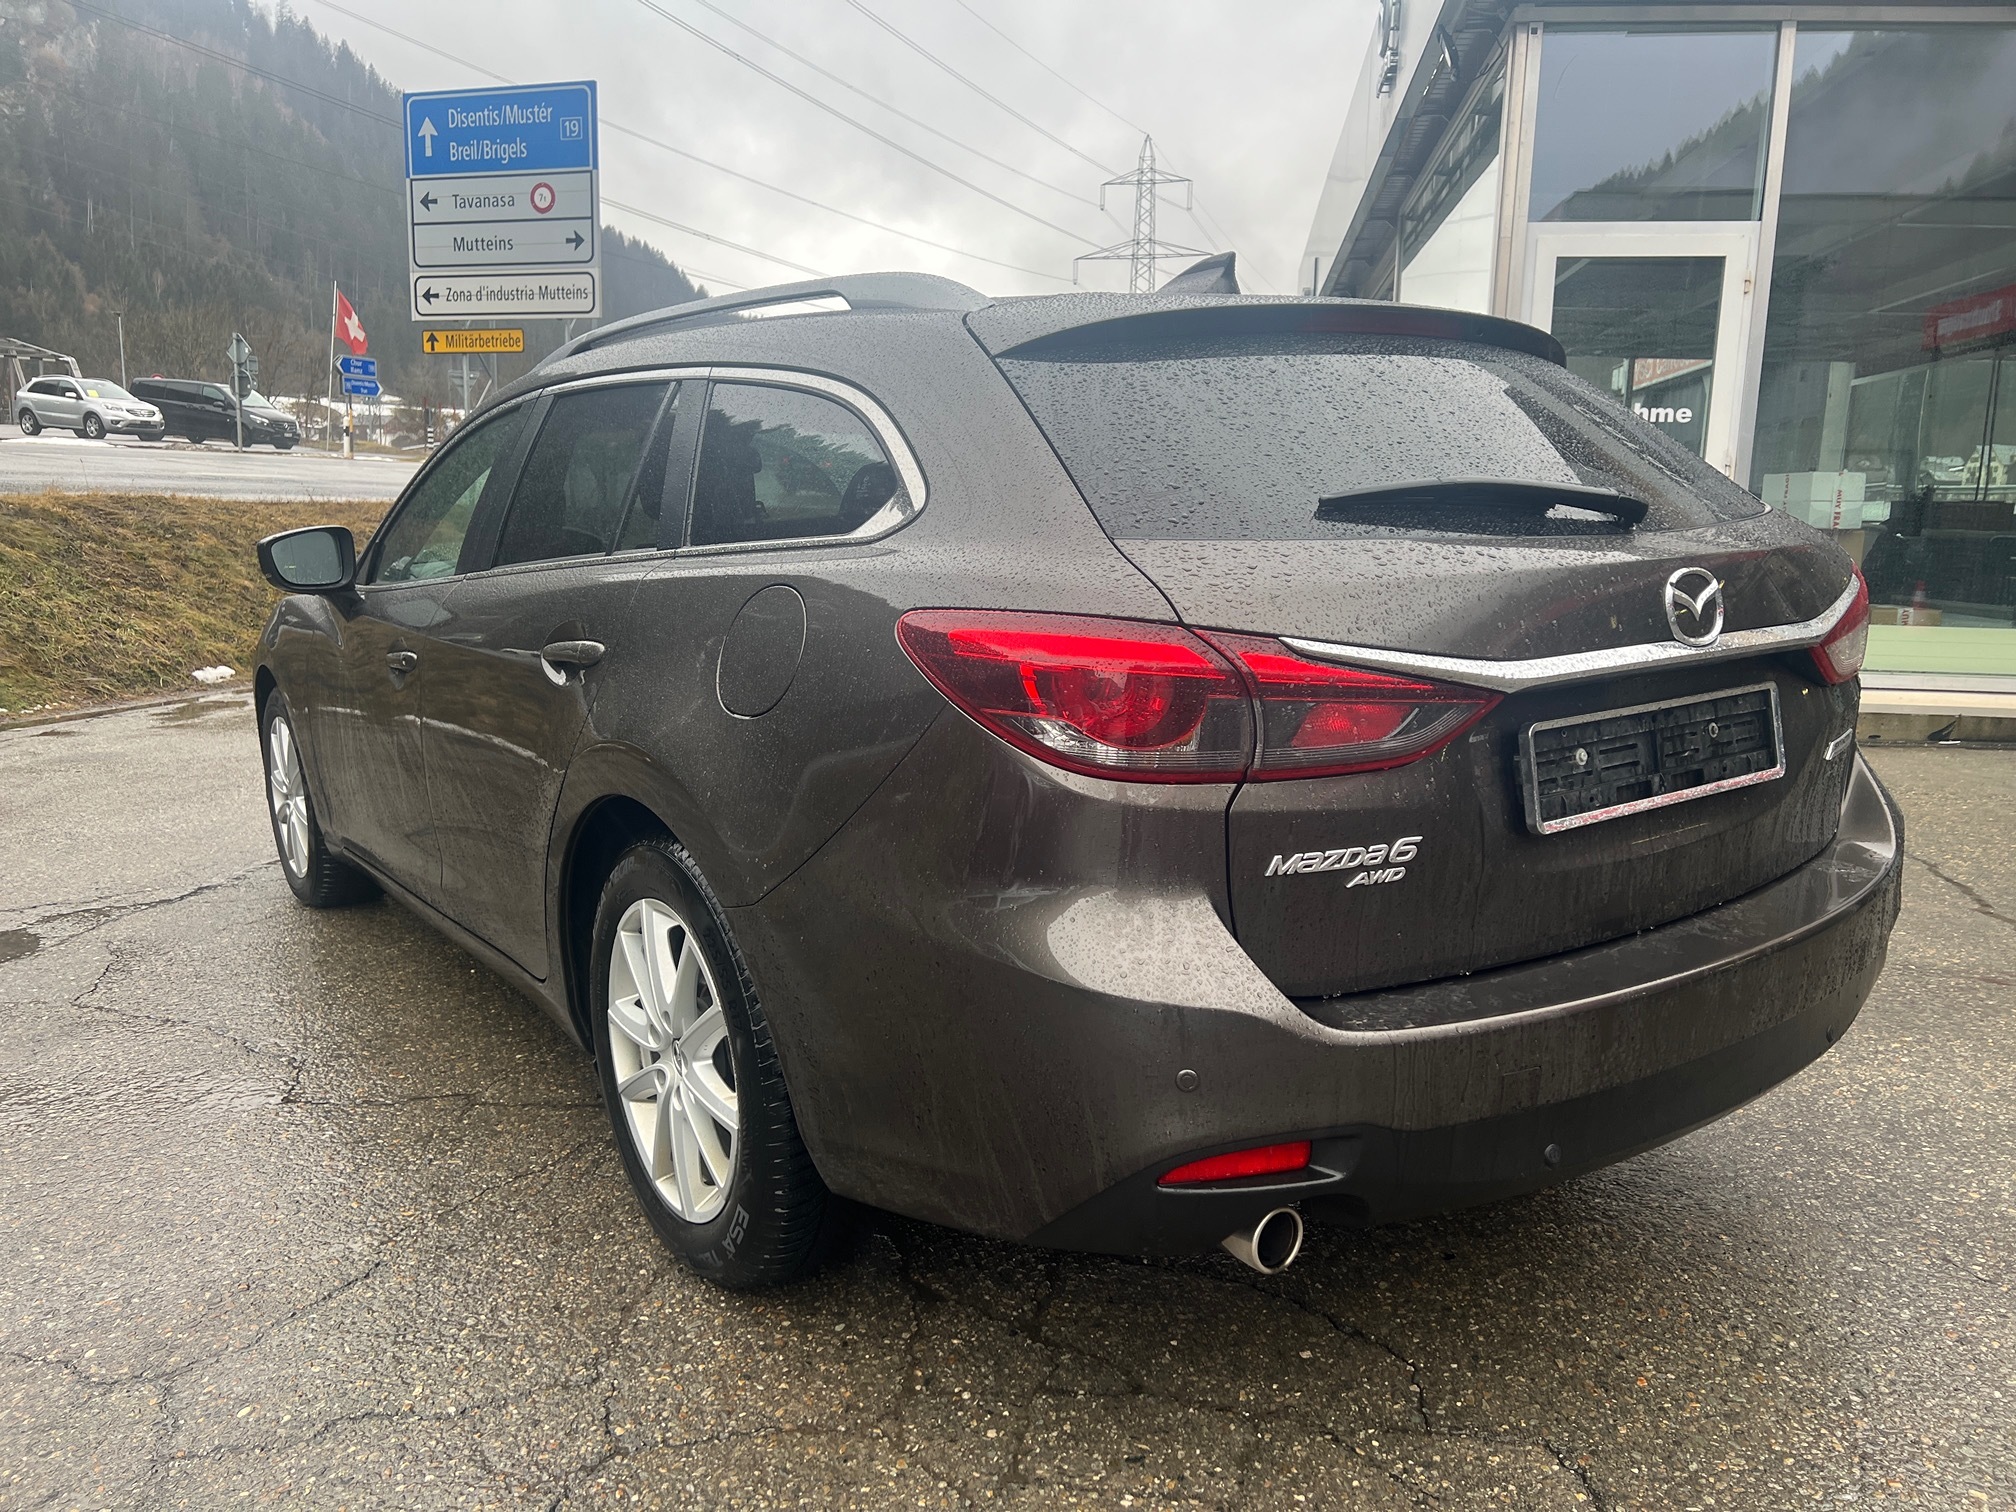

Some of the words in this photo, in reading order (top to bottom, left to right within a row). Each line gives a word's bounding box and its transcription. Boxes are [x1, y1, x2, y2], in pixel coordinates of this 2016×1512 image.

[448, 102, 553, 129] Disentis/Mustér
[563, 120, 579, 137] 19
[449, 137, 527, 164] Breil/Brigels
[452, 194, 515, 209] Tavanasa
[453, 235, 513, 251] Mutteins
[445, 287, 472, 302] Zona
[475, 285, 535, 302] d'industria
[538, 284, 588, 300] Mutteins
[445, 332, 521, 348] Militärbetriebe
[1345, 866, 1406, 888] AWD
